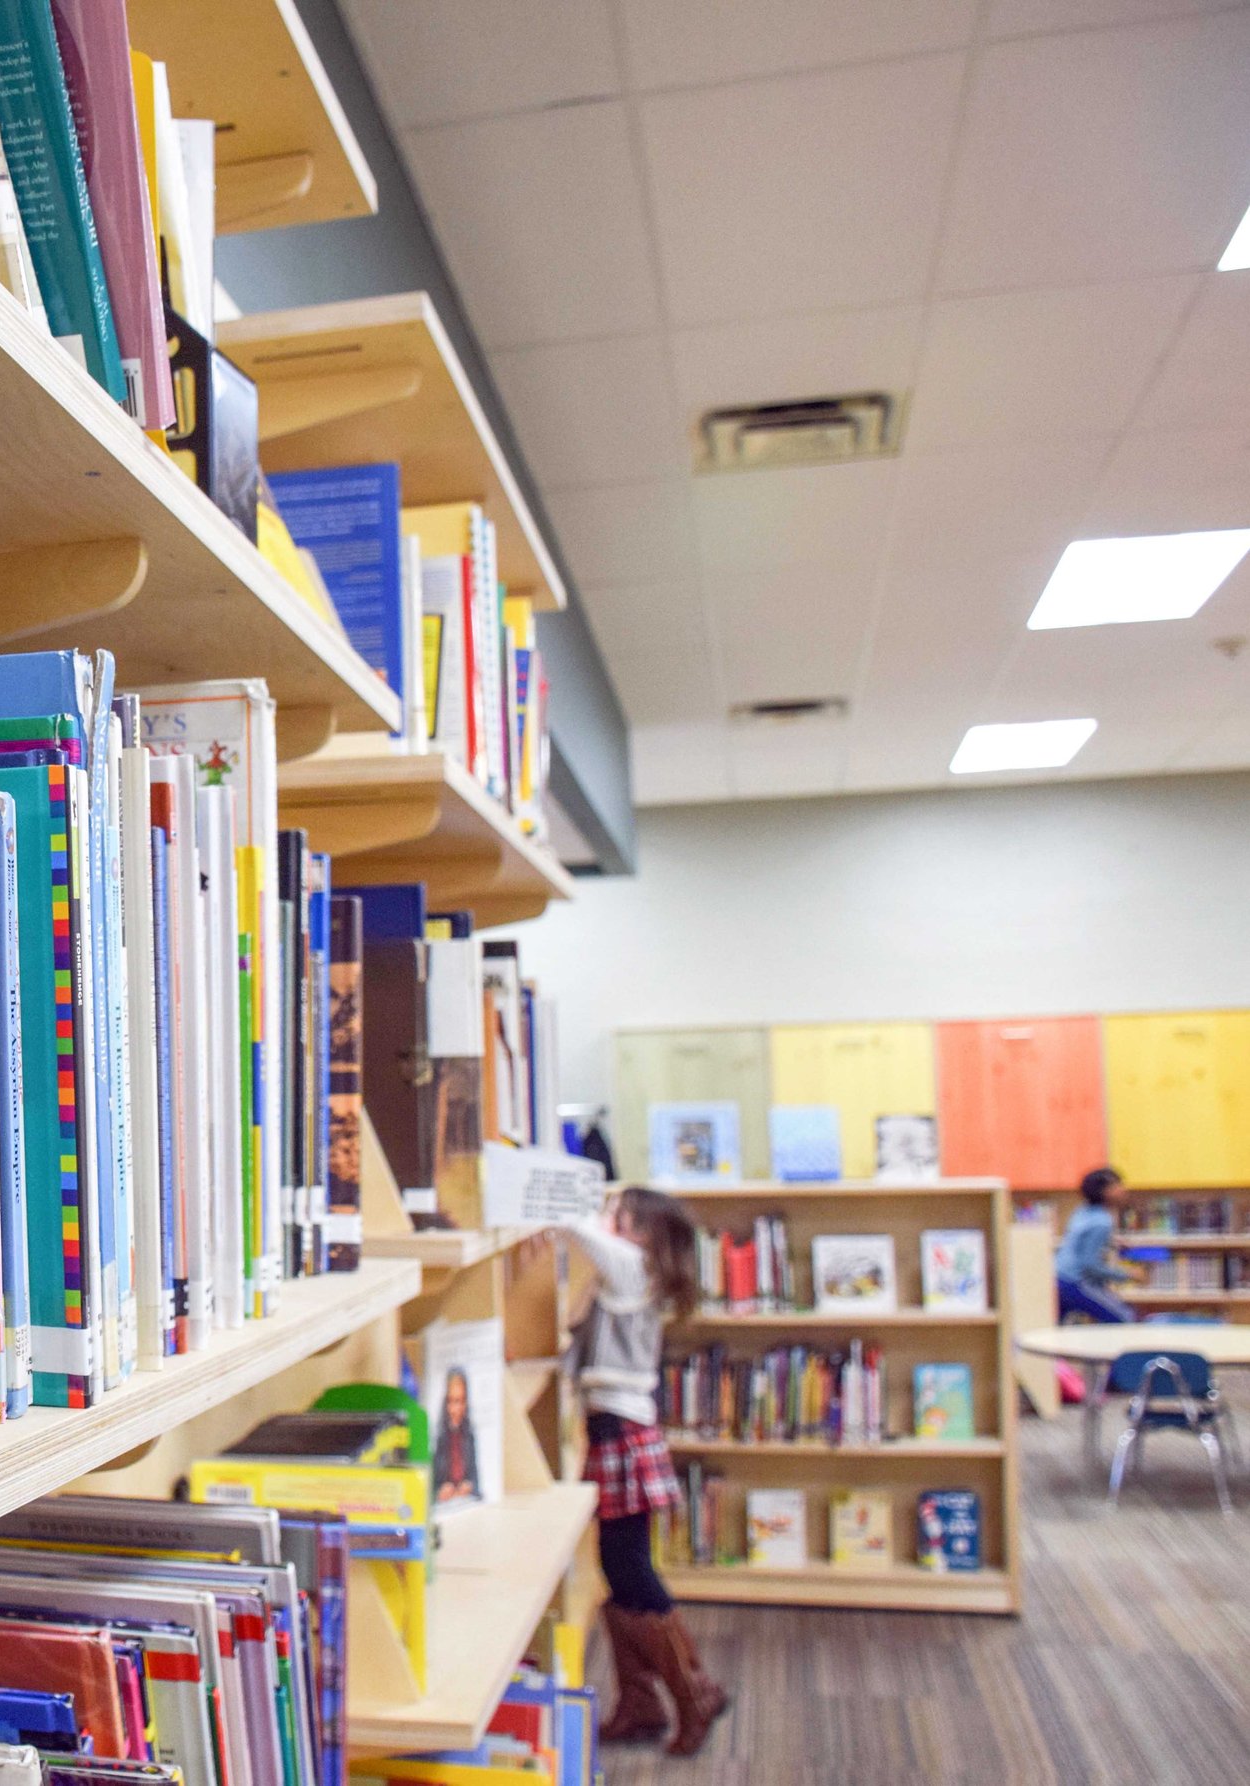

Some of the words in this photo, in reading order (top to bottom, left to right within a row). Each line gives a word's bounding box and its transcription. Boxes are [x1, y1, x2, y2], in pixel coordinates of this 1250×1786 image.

[75, 932, 83, 1007] STONEHENGE
[114, 1001, 122, 1040] The
[10, 1033, 18, 1119] Assyrian
[12, 1127, 20, 1203] Empire
[117, 1124, 125, 1196] Empire
